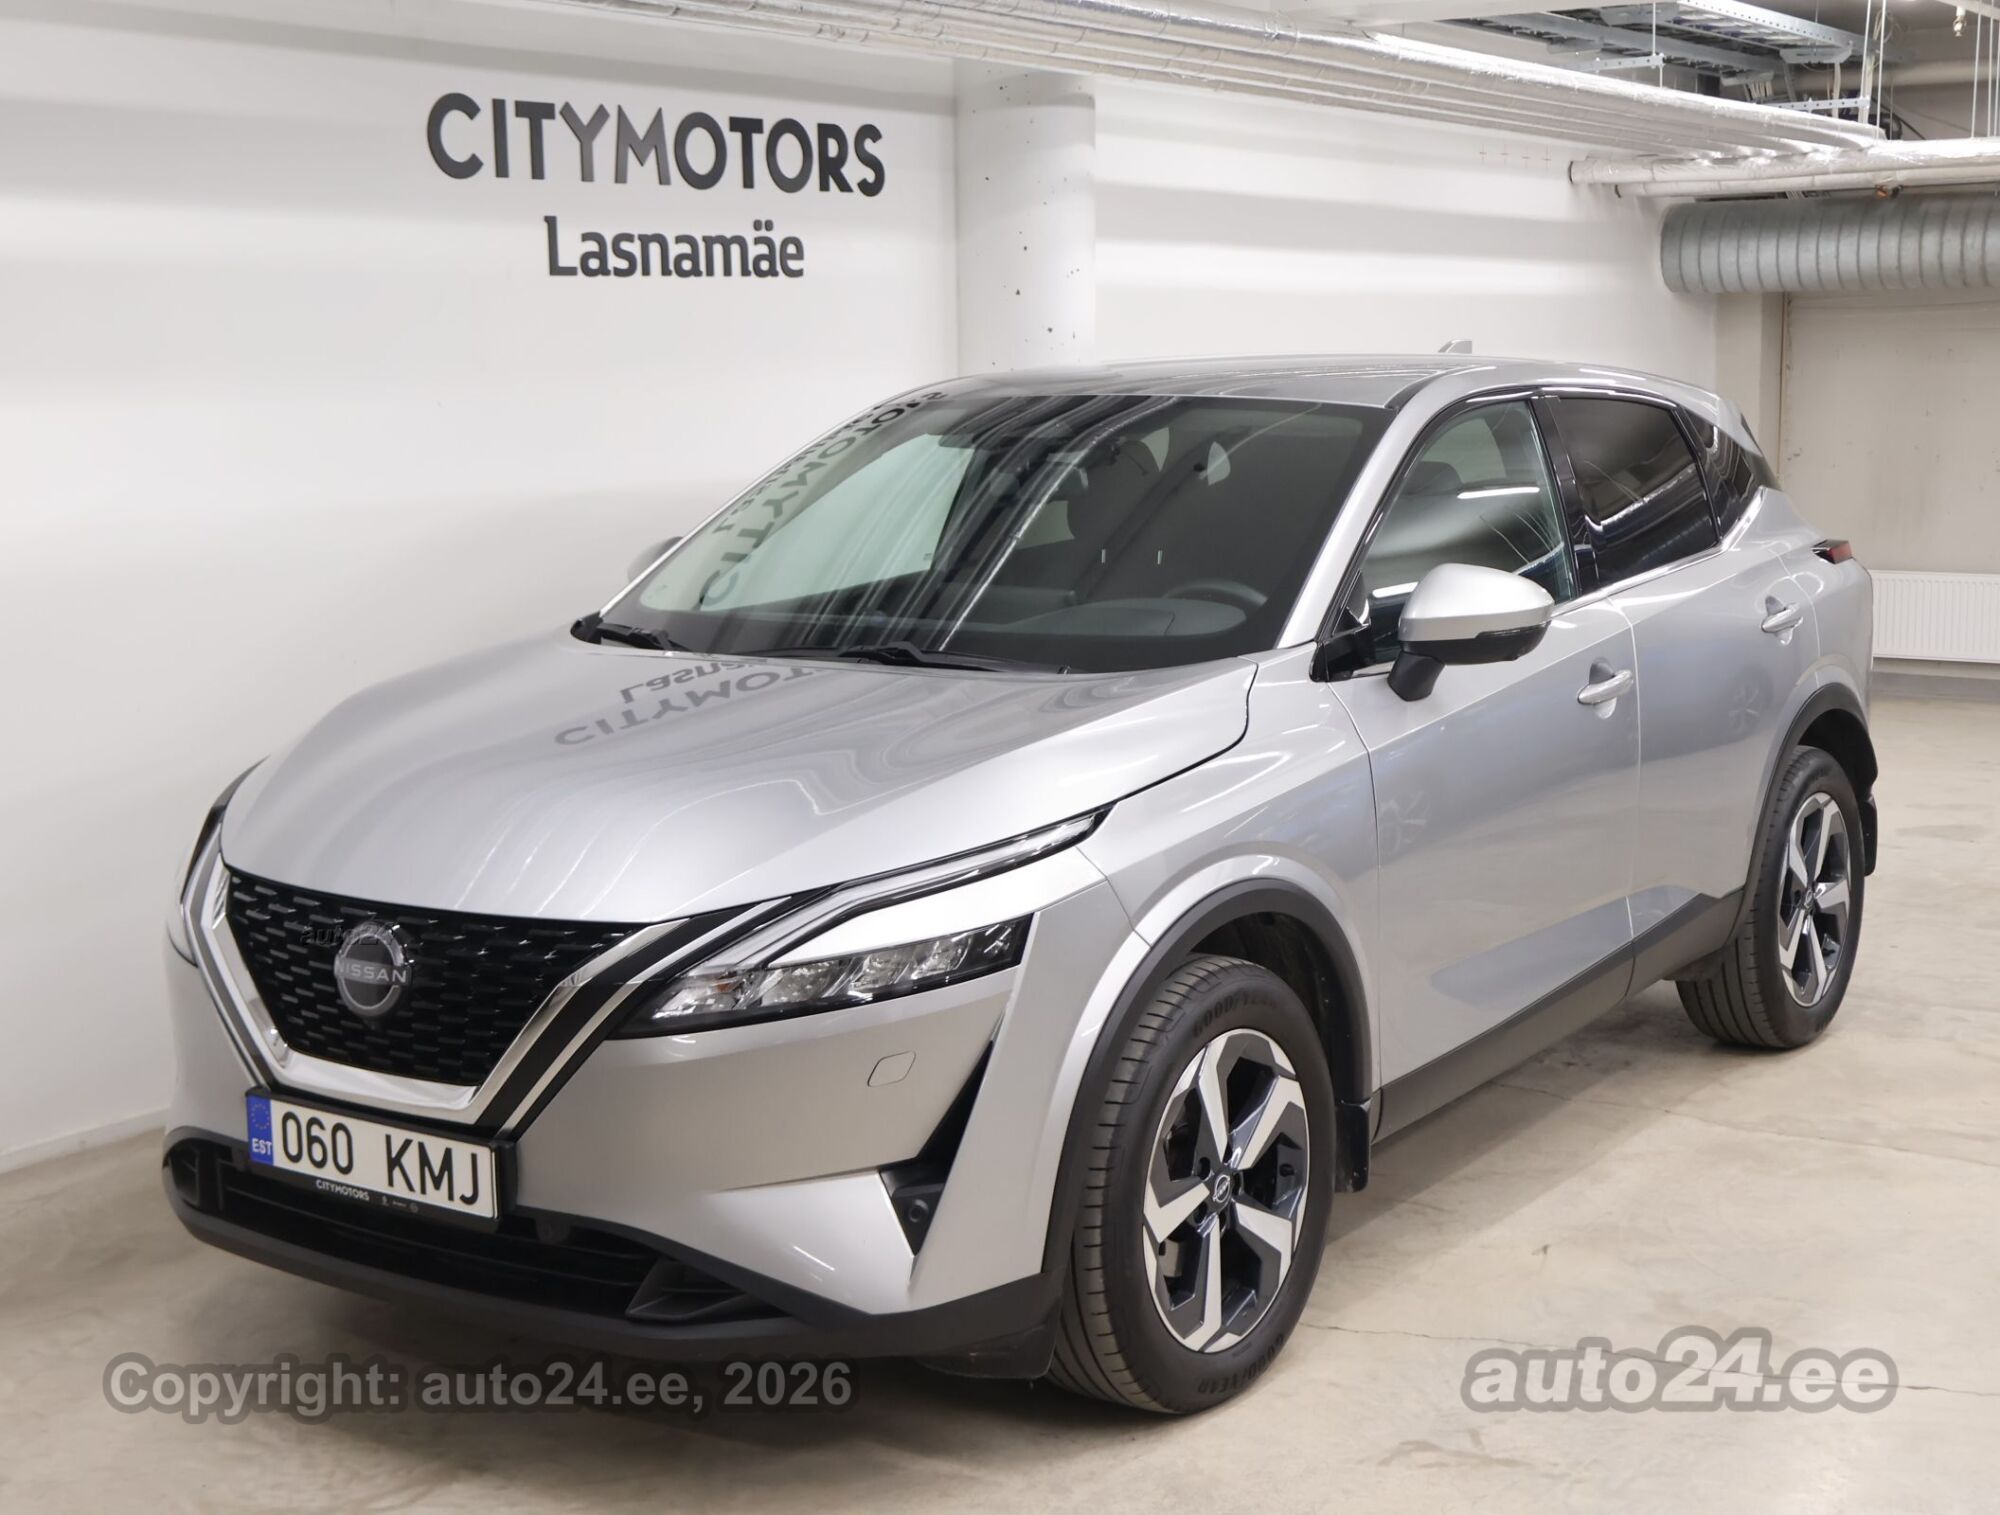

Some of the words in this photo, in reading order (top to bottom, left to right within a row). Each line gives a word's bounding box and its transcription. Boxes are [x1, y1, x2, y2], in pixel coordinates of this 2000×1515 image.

[427, 92, 885, 197] CITYMOTORS
[544, 215, 805, 278] Lasnamäe
[335, 961, 408, 984] NISSAN
[252, 1138, 274, 1156] EST
[282, 1111, 353, 1175] 060
[385, 1134, 479, 1206] KMJ
[315, 1179, 370, 1202] CITYMOTORS
